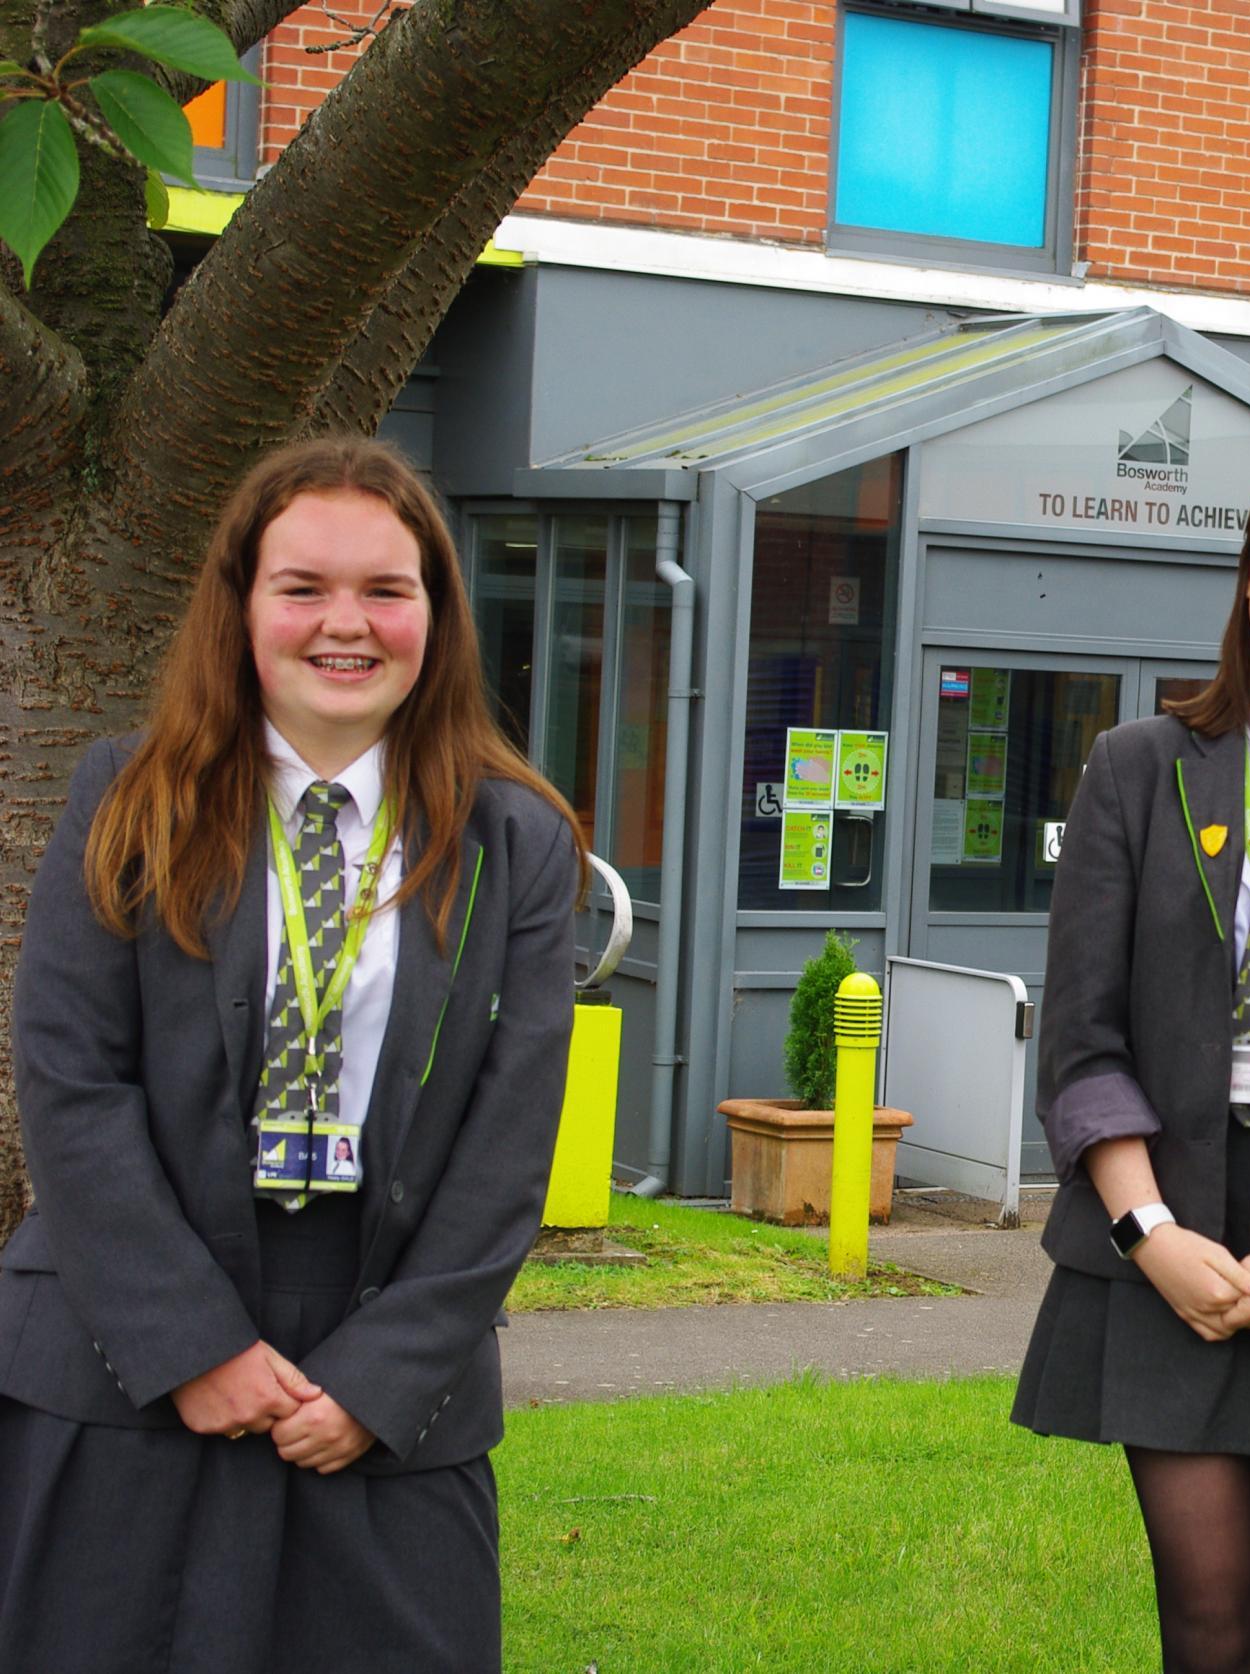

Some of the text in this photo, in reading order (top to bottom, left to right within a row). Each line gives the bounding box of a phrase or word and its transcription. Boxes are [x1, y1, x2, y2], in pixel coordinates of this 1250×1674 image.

[1116, 462, 1188, 483] Bosworth
[1144, 480, 1188, 495] Academy
[1039, 493, 1249, 530] TO LEARN TO ACHIEV
